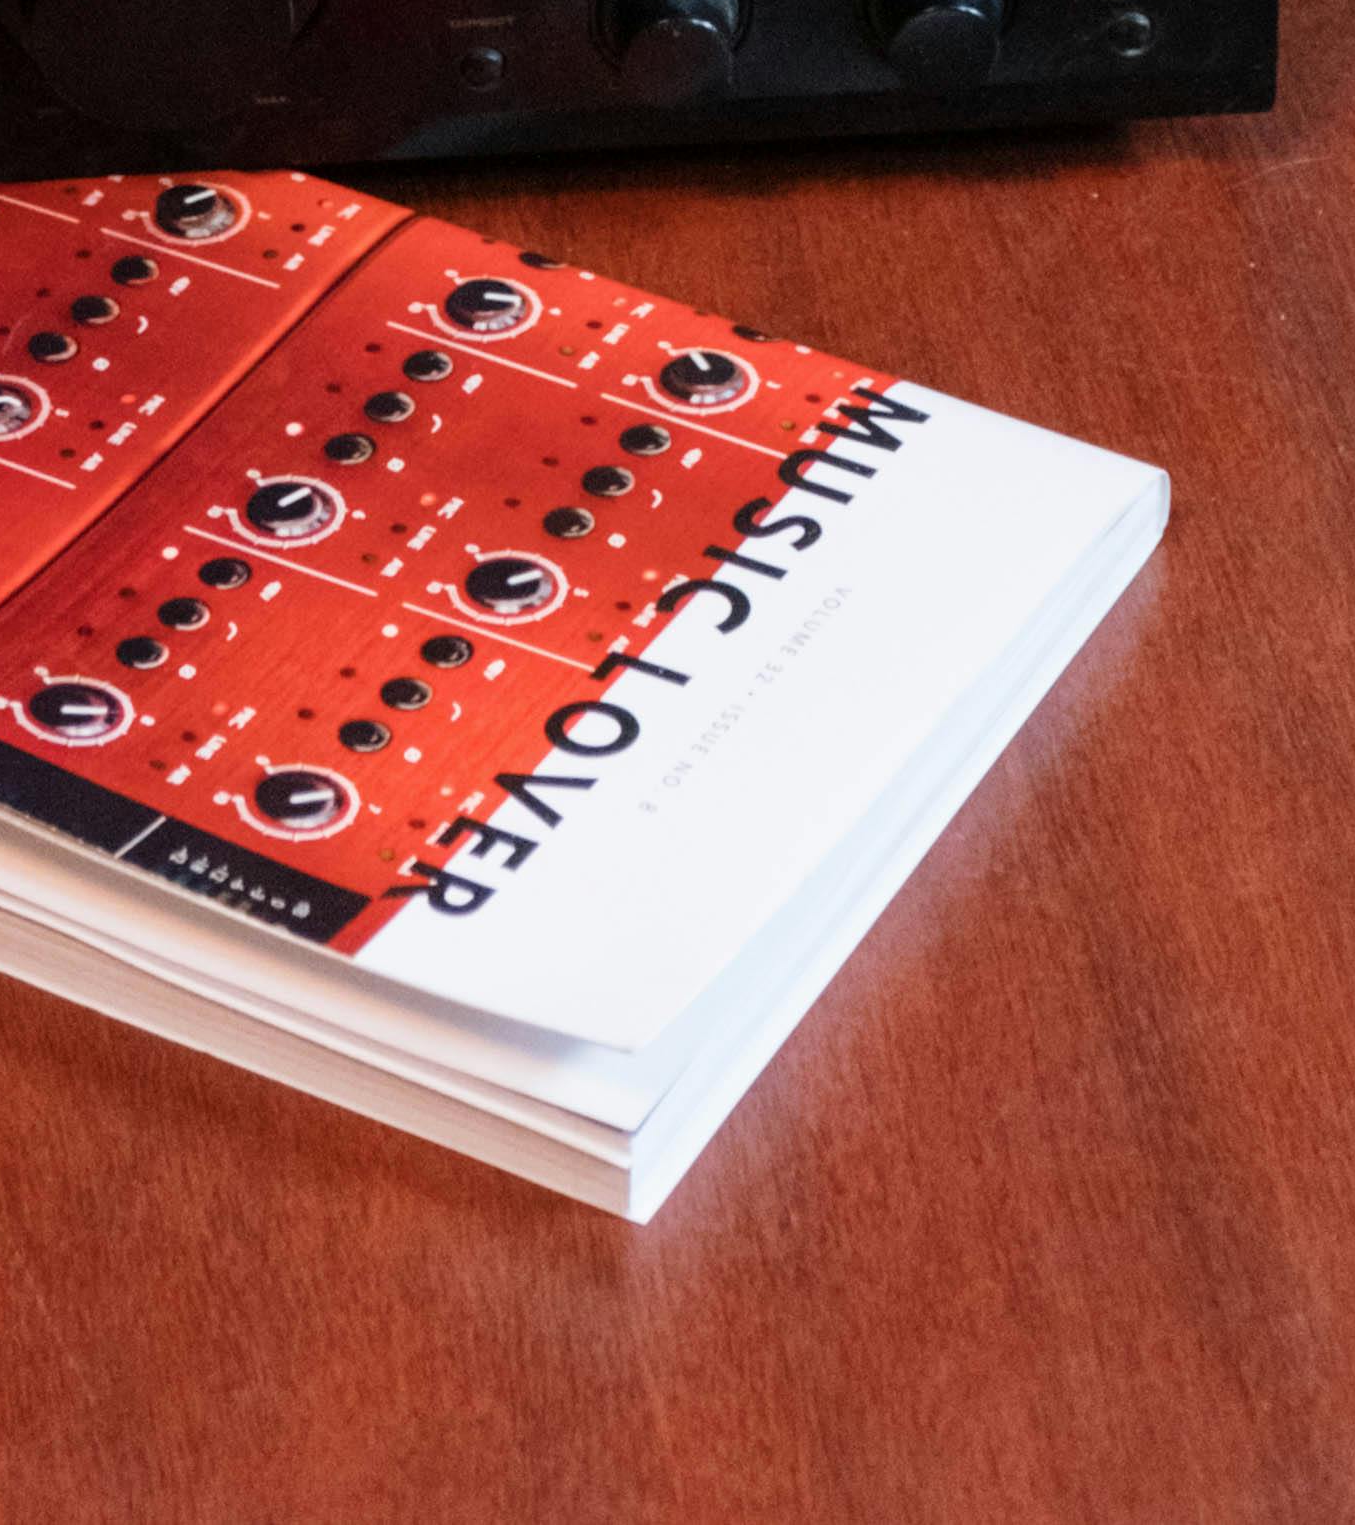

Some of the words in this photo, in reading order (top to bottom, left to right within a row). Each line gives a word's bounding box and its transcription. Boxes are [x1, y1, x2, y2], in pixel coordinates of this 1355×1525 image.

[657, 383, 932, 640] MUSIC
[779, 587, 852, 656] VOLUME
[381, 646, 693, 922] LOVER
[691, 703, 744, 754] ISSUE
